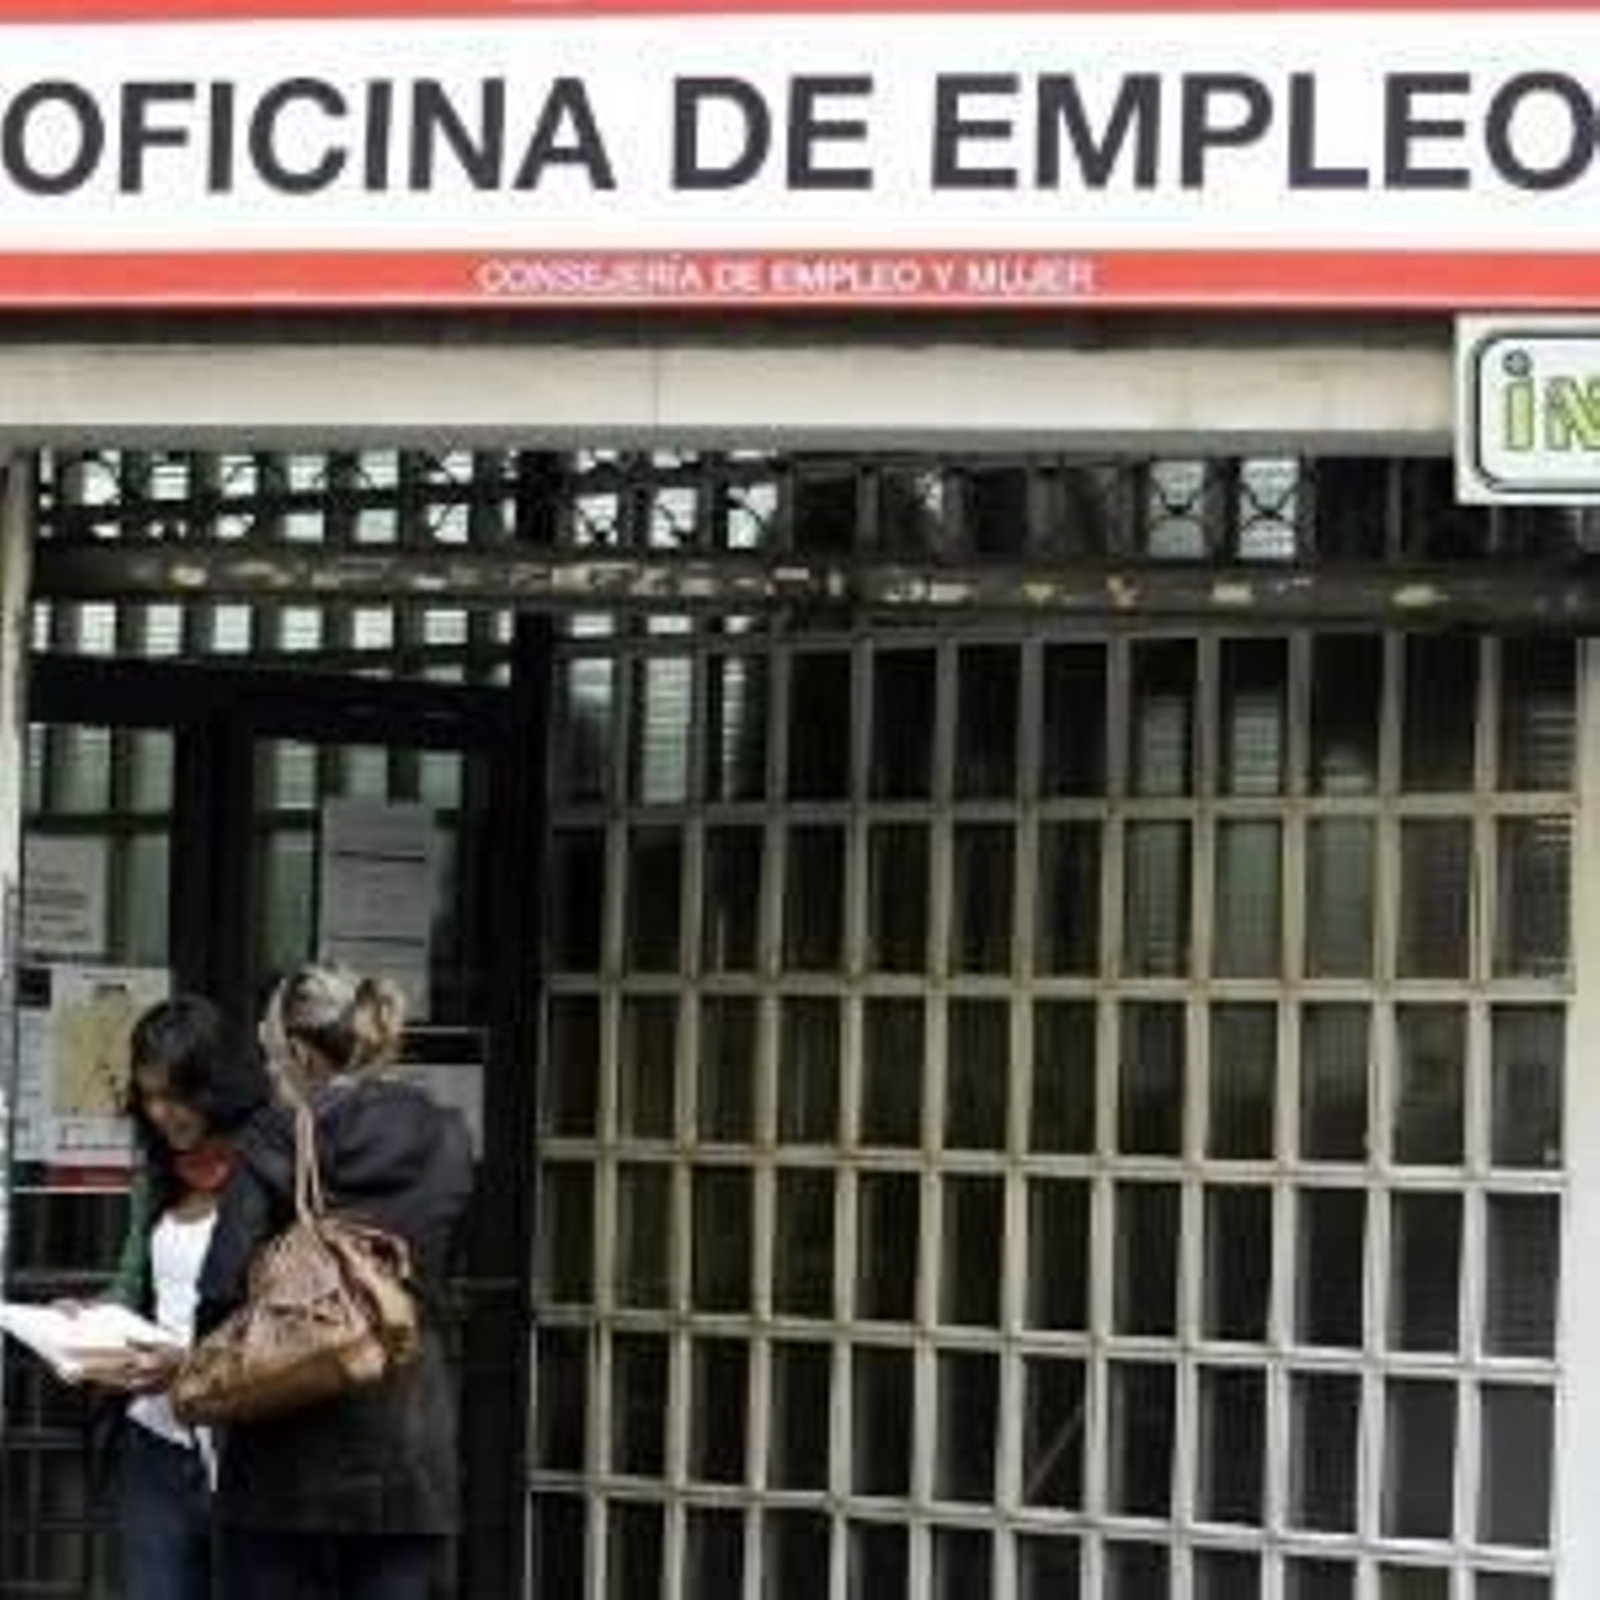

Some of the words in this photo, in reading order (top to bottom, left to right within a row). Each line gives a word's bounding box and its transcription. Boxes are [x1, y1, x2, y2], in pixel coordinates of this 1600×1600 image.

[1, 77, 615, 195] OFICINA
[672, 75, 872, 189] DE
[931, 72, 1599, 190] EMPLEO
[711, 260, 762, 291] DE
[769, 259, 922, 291] EMPLEO
[933, 259, 956, 291] Y
[965, 258, 1094, 292] MUJER
